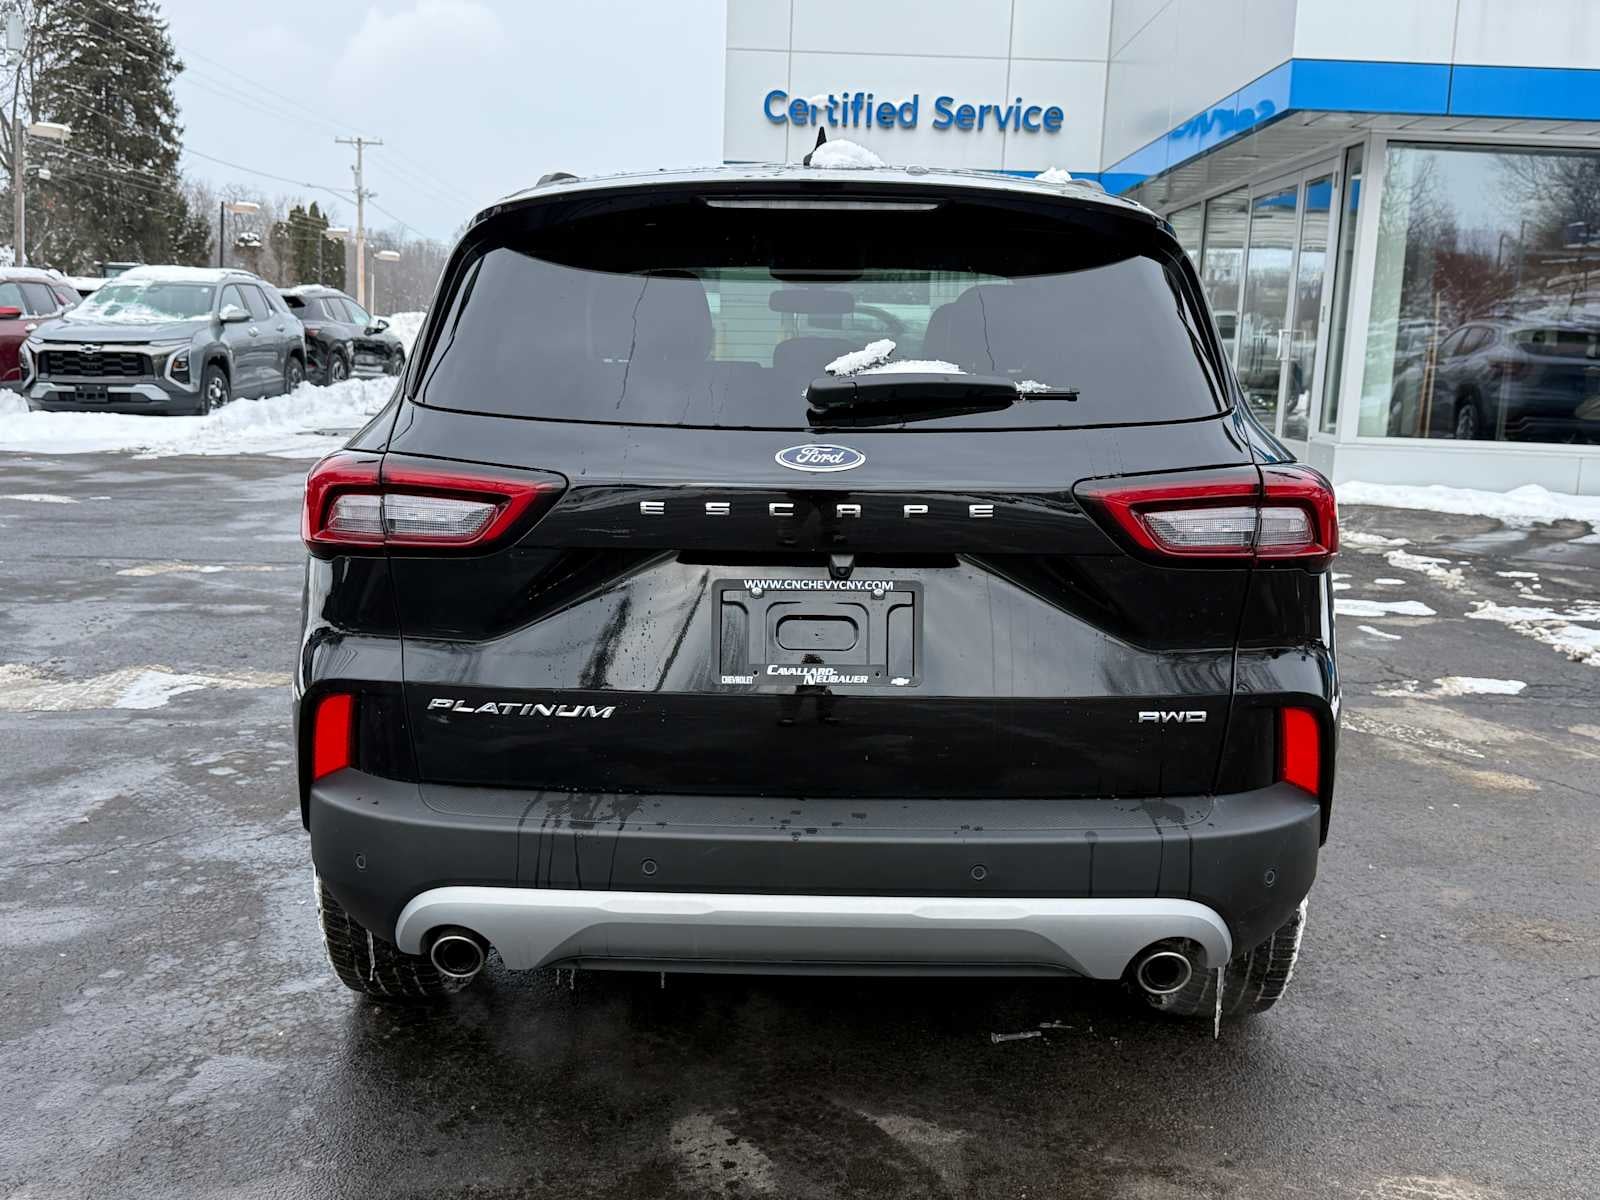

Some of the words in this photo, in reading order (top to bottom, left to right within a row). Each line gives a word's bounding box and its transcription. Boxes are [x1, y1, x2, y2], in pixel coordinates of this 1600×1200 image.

[764, 90, 919, 128] Certified
[932, 96, 1064, 133] Service
[796, 447, 845, 463] Ford
[640, 501, 994, 519] ESCAPE
[743, 579, 894, 591] WWW.CNCHEVYCNY.COM
[721, 675, 754, 685] CHEVROLET
[803, 674, 869, 686] NEUBAUER
[426, 697, 617, 719] PLATINUM
[1137, 710, 1208, 724] AWD
